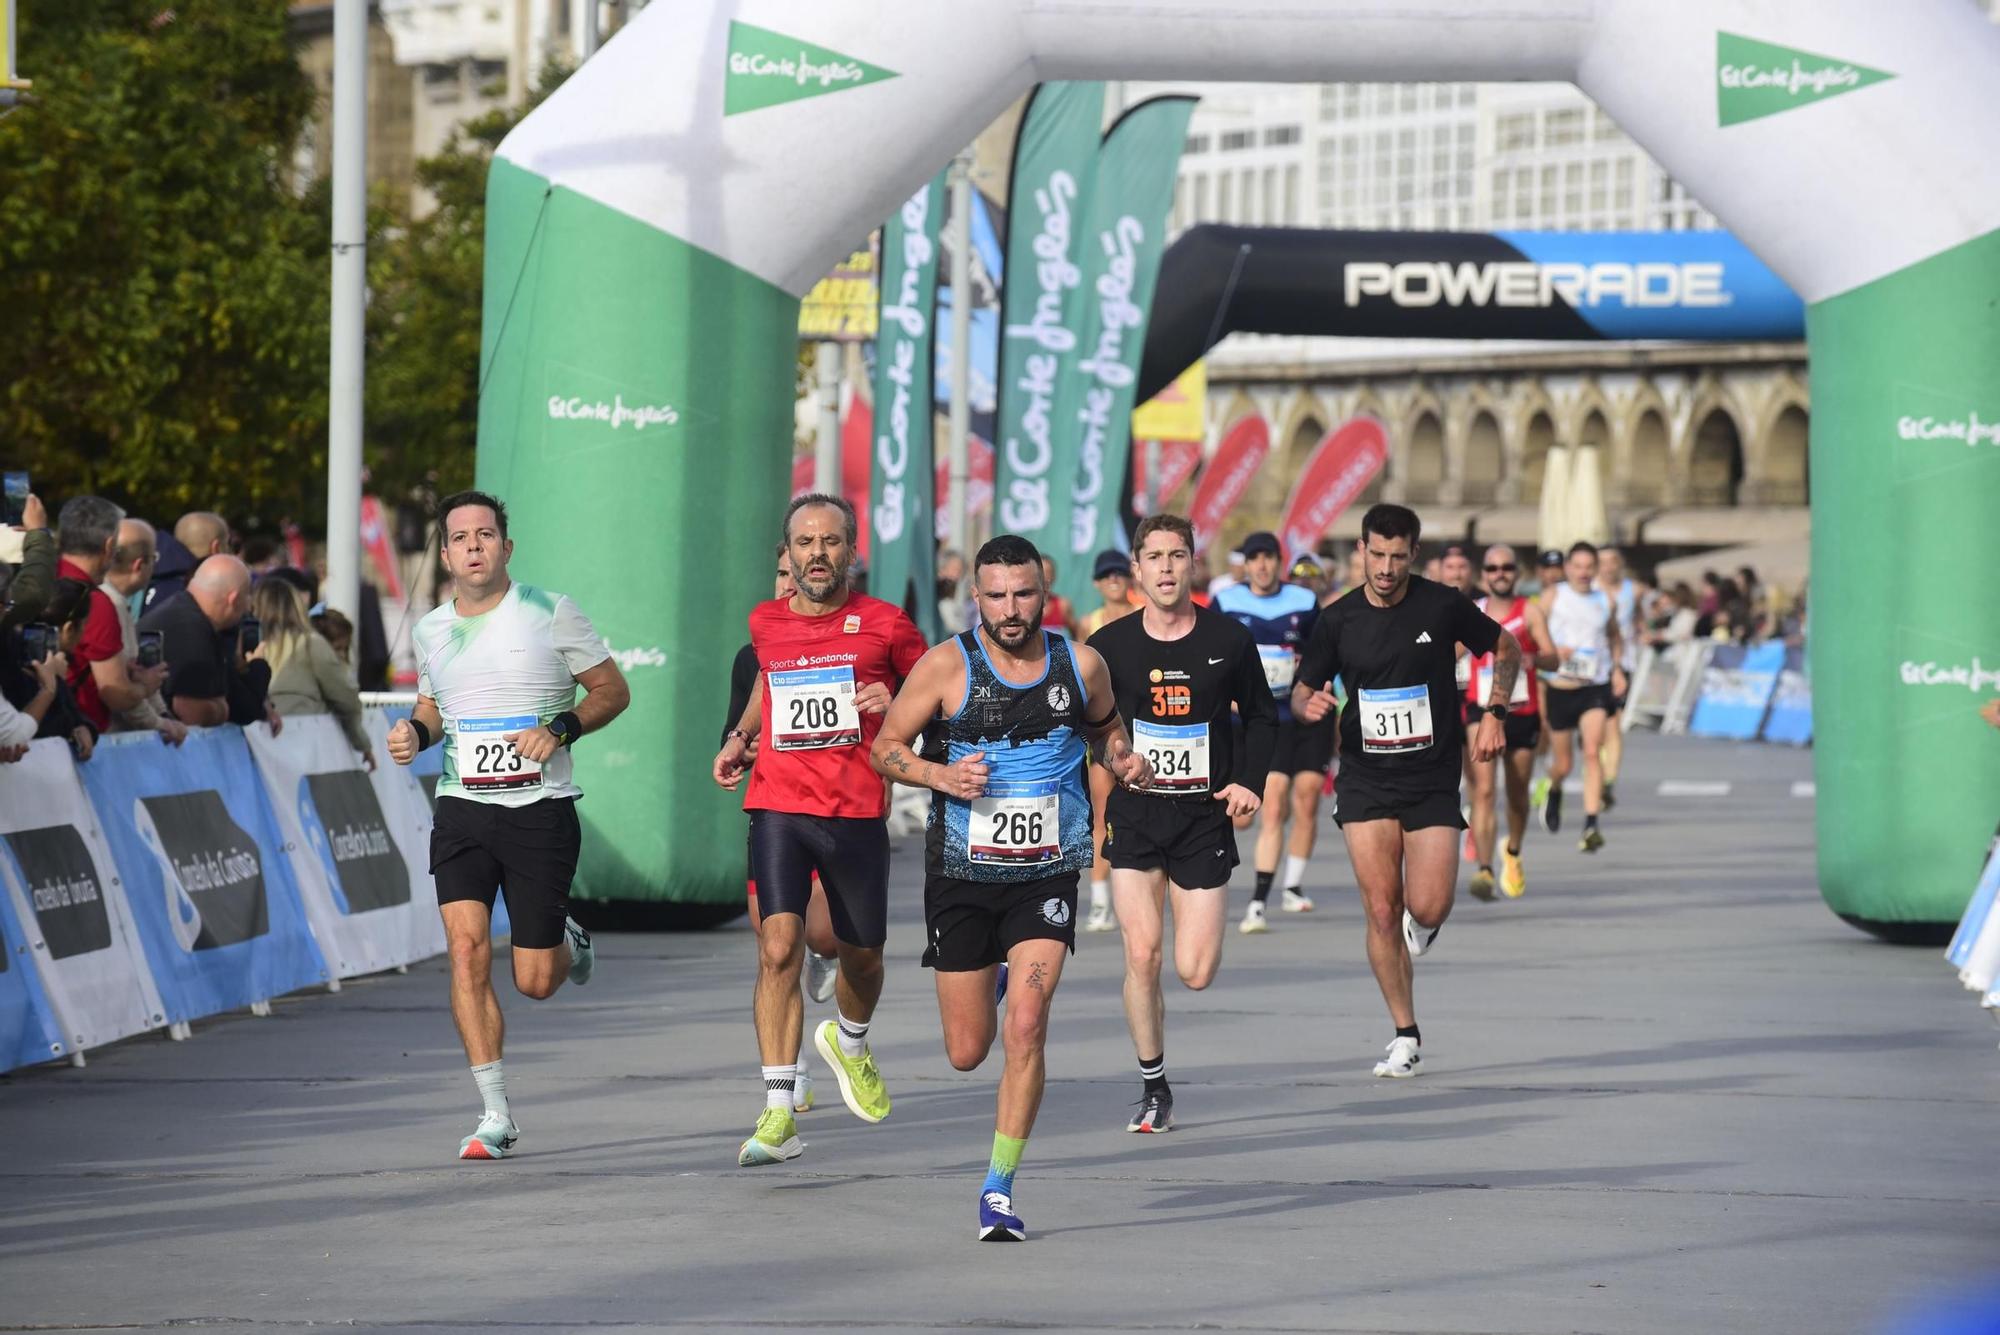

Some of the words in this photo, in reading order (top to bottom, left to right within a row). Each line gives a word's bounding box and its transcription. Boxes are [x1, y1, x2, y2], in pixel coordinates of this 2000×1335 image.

[729, 52, 750, 75] El
[750, 54, 796, 77] Corte
[796, 50, 865, 87] Inglés
[1720, 64, 1741, 88] El
[1741, 64, 1789, 88] Corte
[1788, 57, 1861, 95] Inglés
[1005, 170, 1082, 352] Inglés
[1077, 214, 1145, 387] Inglés
[1344, 262, 1724, 307] POWERADE
[548, 395, 566, 419] El
[566, 397, 610, 421] Corte
[610, 394, 679, 430] Inglés
[877, 338, 916, 480] Corte
[1005, 353, 1058, 478] Corte
[1071, 386, 1116, 504] Corte
[1897, 416, 1918, 440] El
[1918, 416, 1966, 440] Corte
[873, 481, 906, 544] El
[1000, 477, 1051, 532] El
[769, 659, 796, 671] Sports
[810, 653, 858, 665] Santander
[1900, 661, 1921, 685] El
[1921, 661, 1969, 685] Corte
[790, 697, 839, 730] 208
[1151, 686, 1191, 717] 31D
[1376, 710, 1413, 737] 311
[475, 743, 522, 773] 223
[1149, 748, 1192, 776] 334
[992, 812, 1043, 845] 266
